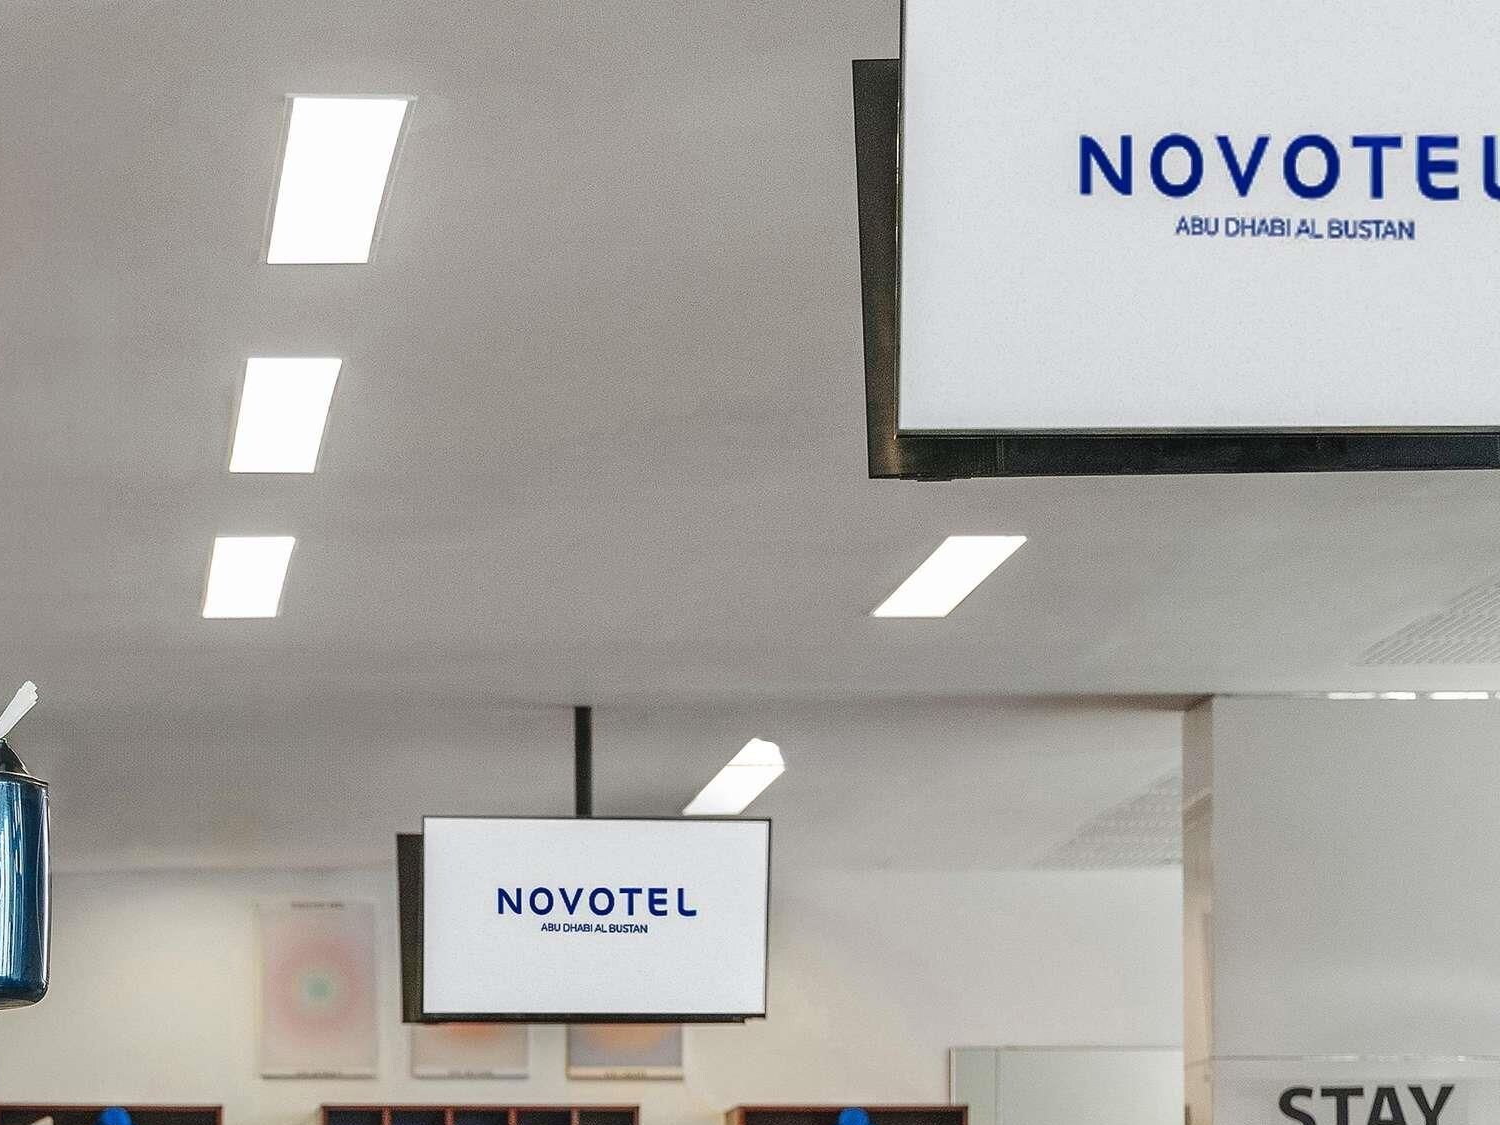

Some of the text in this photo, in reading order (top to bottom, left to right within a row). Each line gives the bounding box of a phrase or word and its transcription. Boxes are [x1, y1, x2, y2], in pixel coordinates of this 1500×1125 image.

[1175, 216, 1416, 240] ABU DHABI AL BUSTAN
[497, 886, 697, 917] NOVOTEL
[540, 922, 649, 934] ABU DHABI AL BUSTAN
